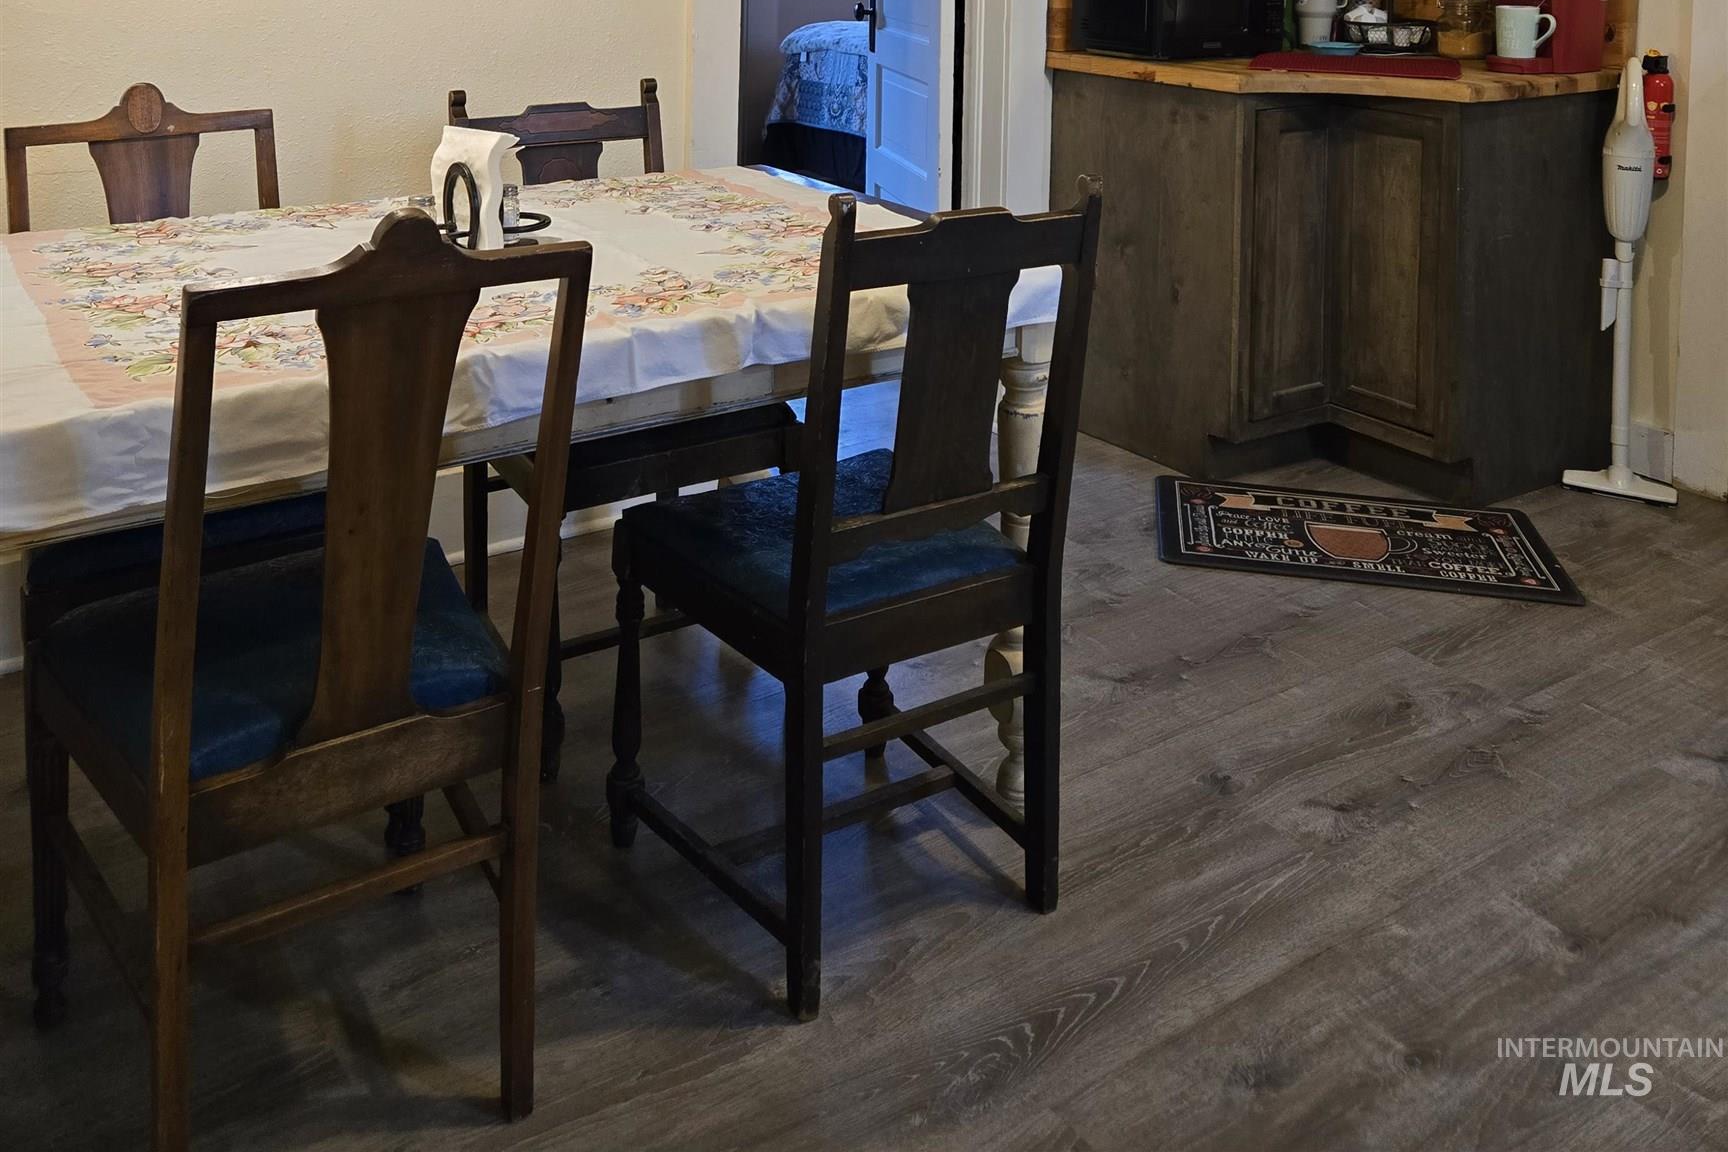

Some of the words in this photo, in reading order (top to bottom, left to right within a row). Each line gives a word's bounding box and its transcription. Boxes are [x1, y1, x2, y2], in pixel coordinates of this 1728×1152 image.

[1276, 496, 1411, 519] COFFEE
[1258, 515, 1290, 524] LOVE
[1221, 538, 1253, 548] ANY
[1245, 550, 1291, 562] WAKE
[1300, 555, 1319, 565] UP
[1352, 561, 1406, 574] SMELL
[1428, 561, 1502, 576] COFFEE
[1440, 571, 1499, 583] COFFEE
